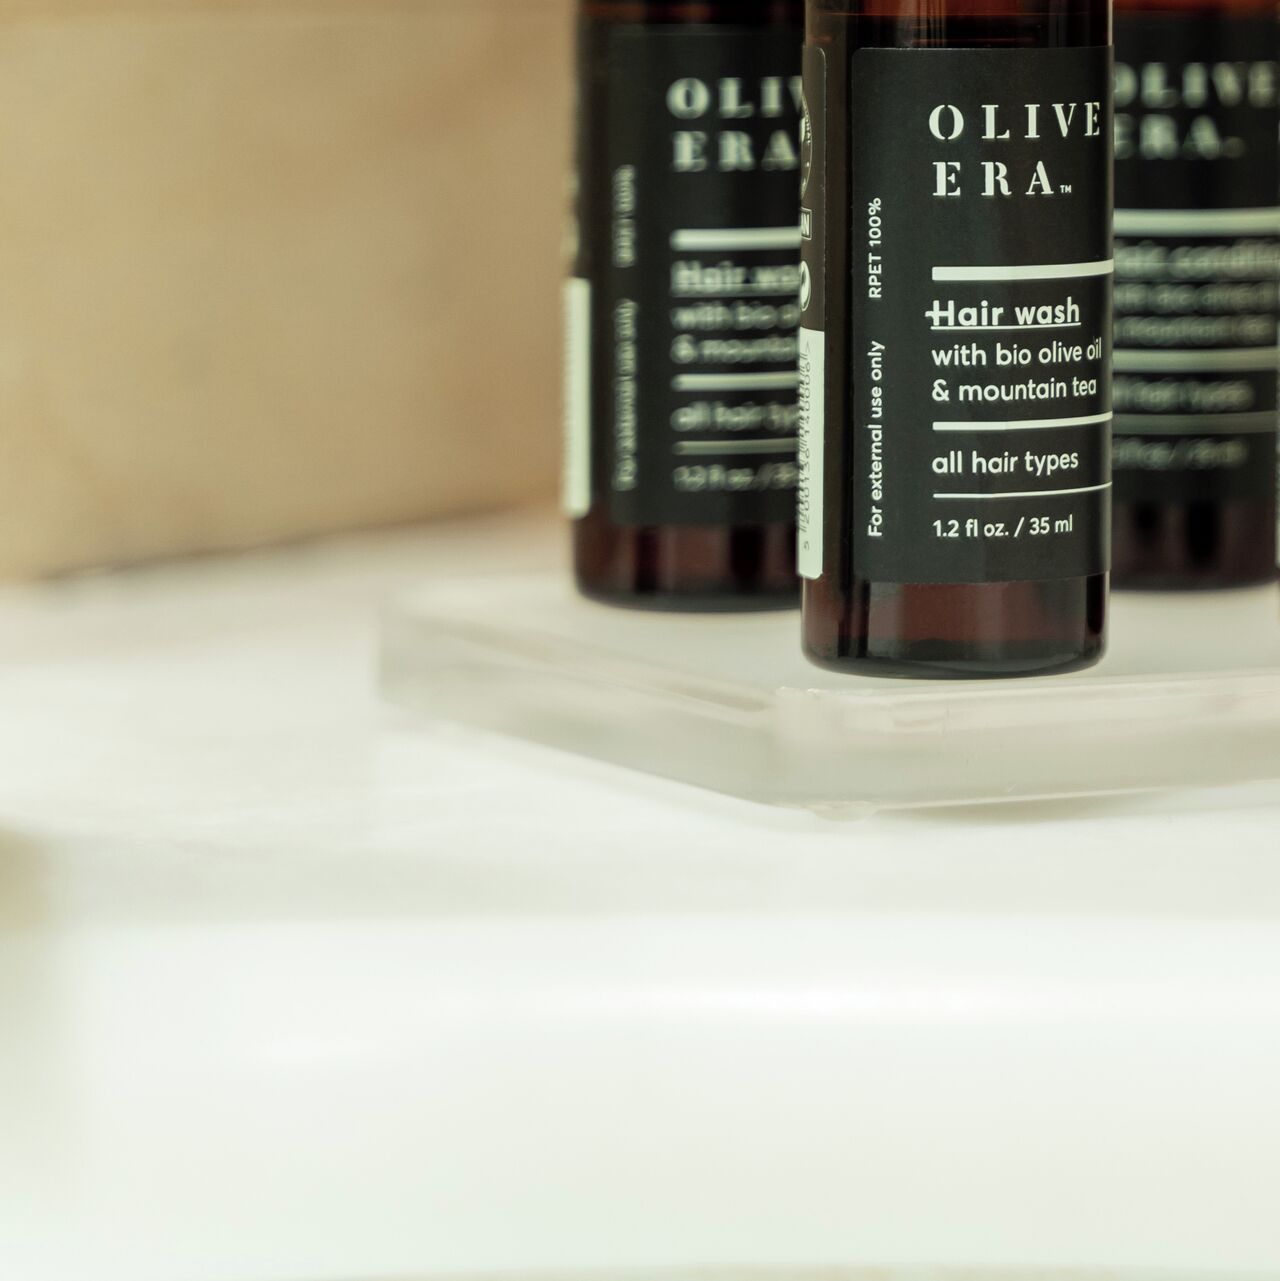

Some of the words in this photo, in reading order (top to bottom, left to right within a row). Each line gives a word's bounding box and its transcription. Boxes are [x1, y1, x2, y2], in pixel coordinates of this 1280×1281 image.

[929, 102, 1099, 140] OLIVE
[868, 198, 881, 247] 100%
[869, 253, 881, 298] RPET
[926, 300, 1003, 325] Hair
[1015, 297, 1081, 324] wash
[867, 341, 885, 381] only
[932, 343, 986, 366] with
[996, 343, 1031, 365] bio
[1039, 341, 1082, 363] olive
[1087, 337, 1101, 360] oil
[872, 387, 882, 418] use
[932, 379, 949, 401] &
[959, 378, 1066, 401] mountain
[1072, 377, 1096, 396] tea
[868, 425, 882, 500] external
[932, 451, 962, 473] all
[972, 451, 1018, 473] hair
[1025, 451, 1078, 476] types
[868, 506, 882, 537] For
[933, 520, 959, 537] 1.2
[965, 519, 978, 537] fl
[984, 523, 1008, 537] oz.
[1014, 517, 1024, 537] /
[1030, 517, 1050, 535] 35
[1055, 514, 1072, 532] ml
